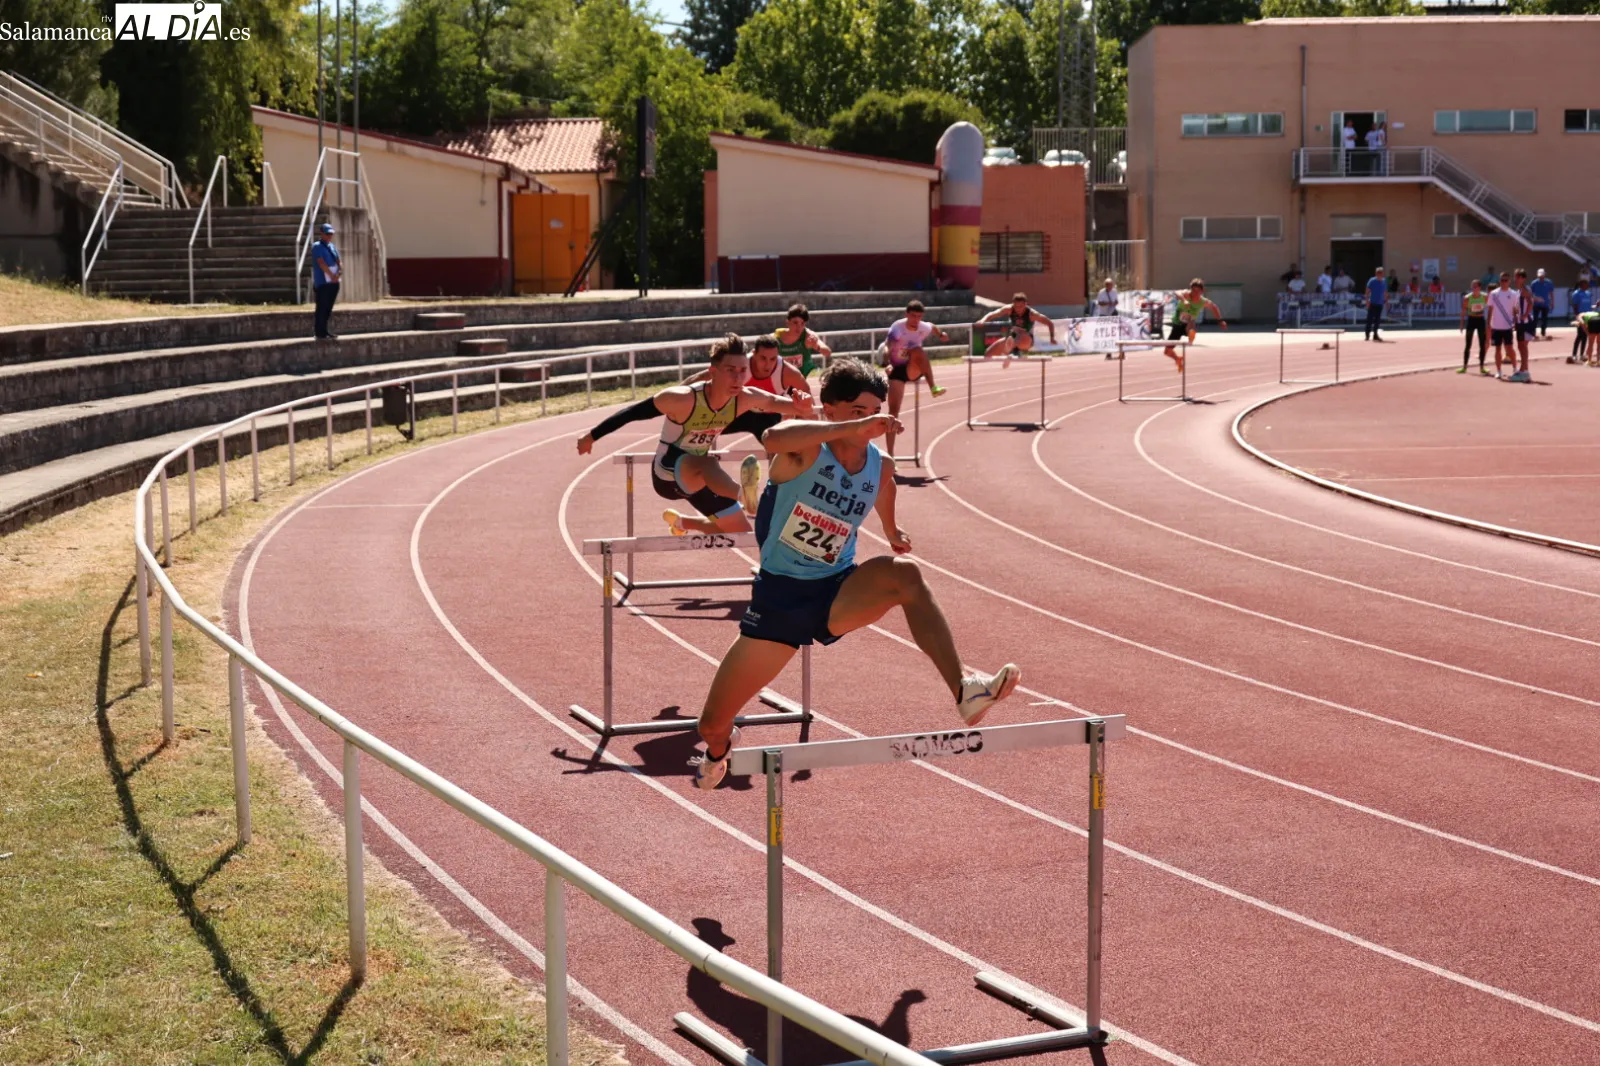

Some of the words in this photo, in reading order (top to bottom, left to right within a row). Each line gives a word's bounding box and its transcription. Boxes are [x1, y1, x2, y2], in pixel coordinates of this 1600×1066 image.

[688, 432, 716, 445] 283
[808, 481, 867, 517] nerja
[792, 521, 838, 553] 224
